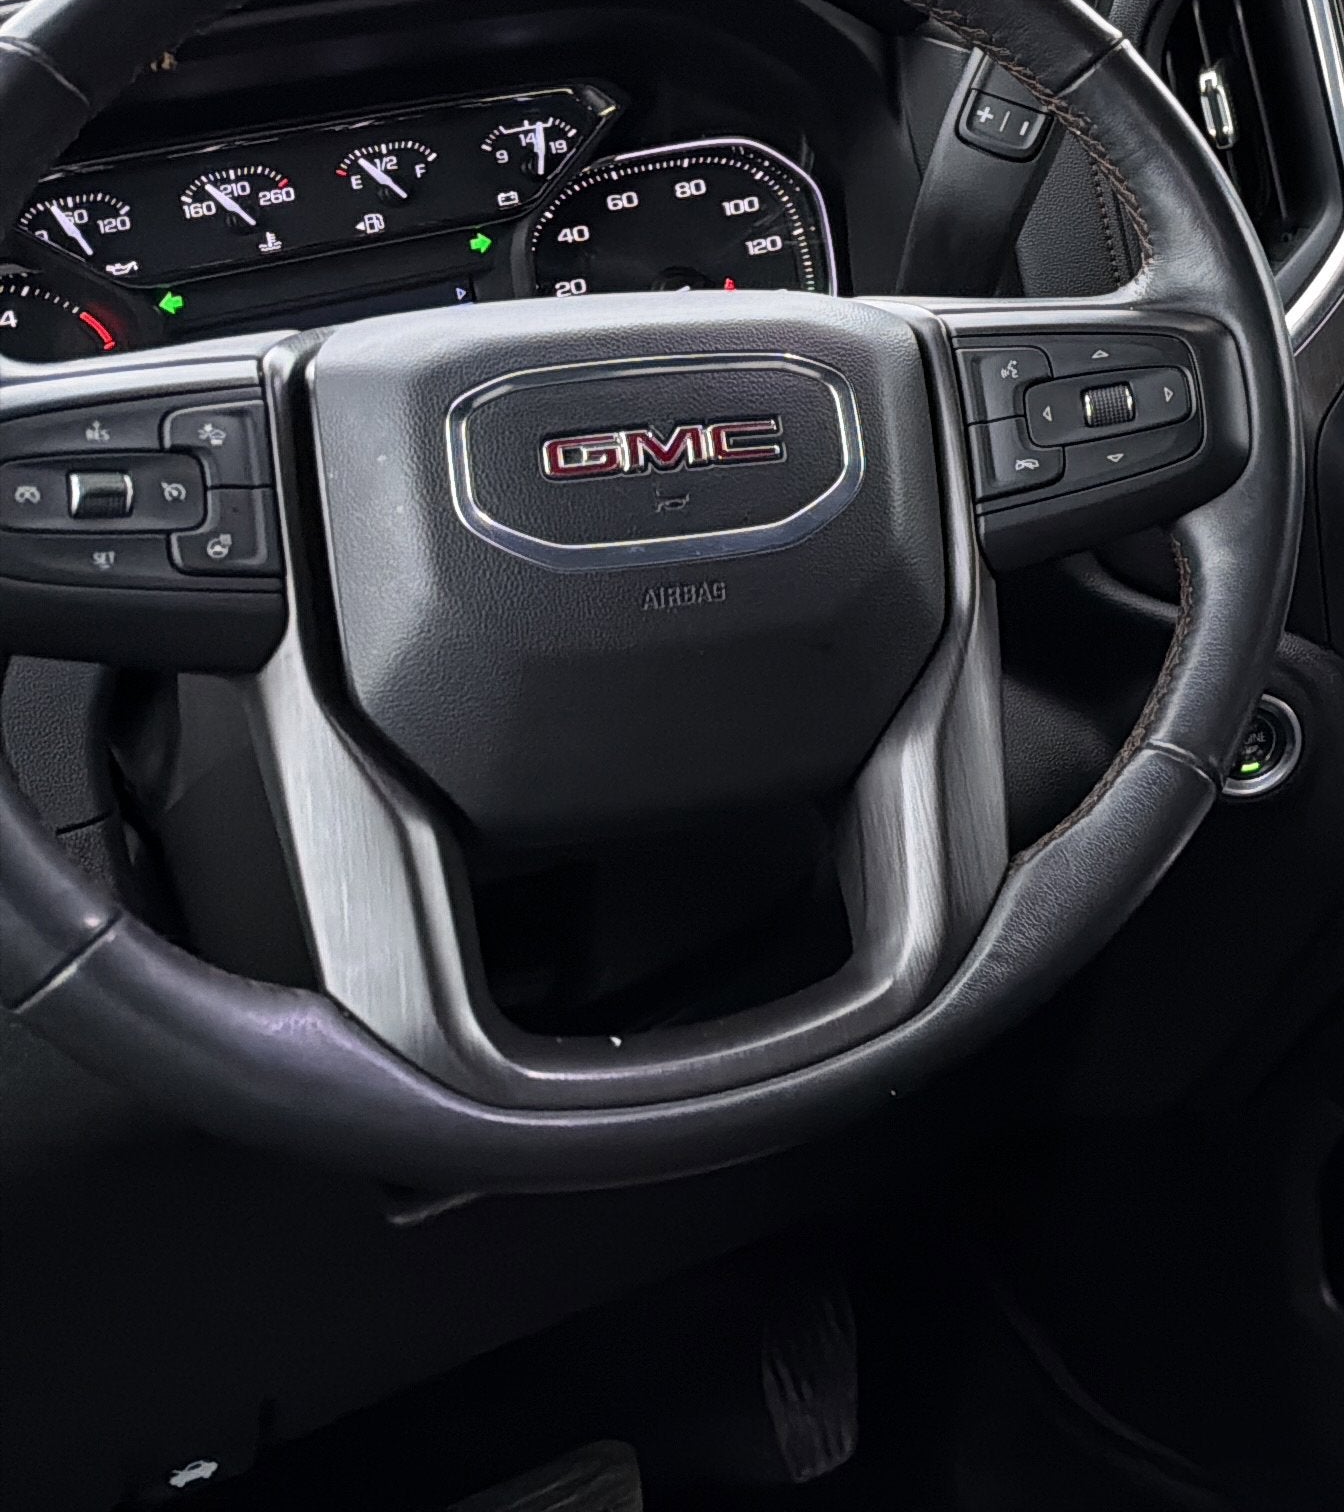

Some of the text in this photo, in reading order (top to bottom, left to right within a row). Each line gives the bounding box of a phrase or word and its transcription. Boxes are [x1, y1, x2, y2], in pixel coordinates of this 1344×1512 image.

[549, 139, 568, 154] 19
[495, 150, 509, 164] 9
[414, 163, 427, 179] F
[219, 180, 250, 198] 210
[351, 175, 364, 190] E
[674, 178, 707, 199] 80
[258, 187, 296, 206] 260
[606, 191, 639, 211] 60
[183, 201, 216, 219] 160
[721, 196, 760, 217] 100
[97, 216, 131, 234] 120
[557, 225, 590, 243] 40
[744, 235, 783, 256] 120
[554, 278, 587, 298] 20
[0, 309, 18, 328] 4
[541, 418, 783, 480] GMC
[92, 551, 115, 565] SET
[641, 580, 727, 613] AIRBAG
